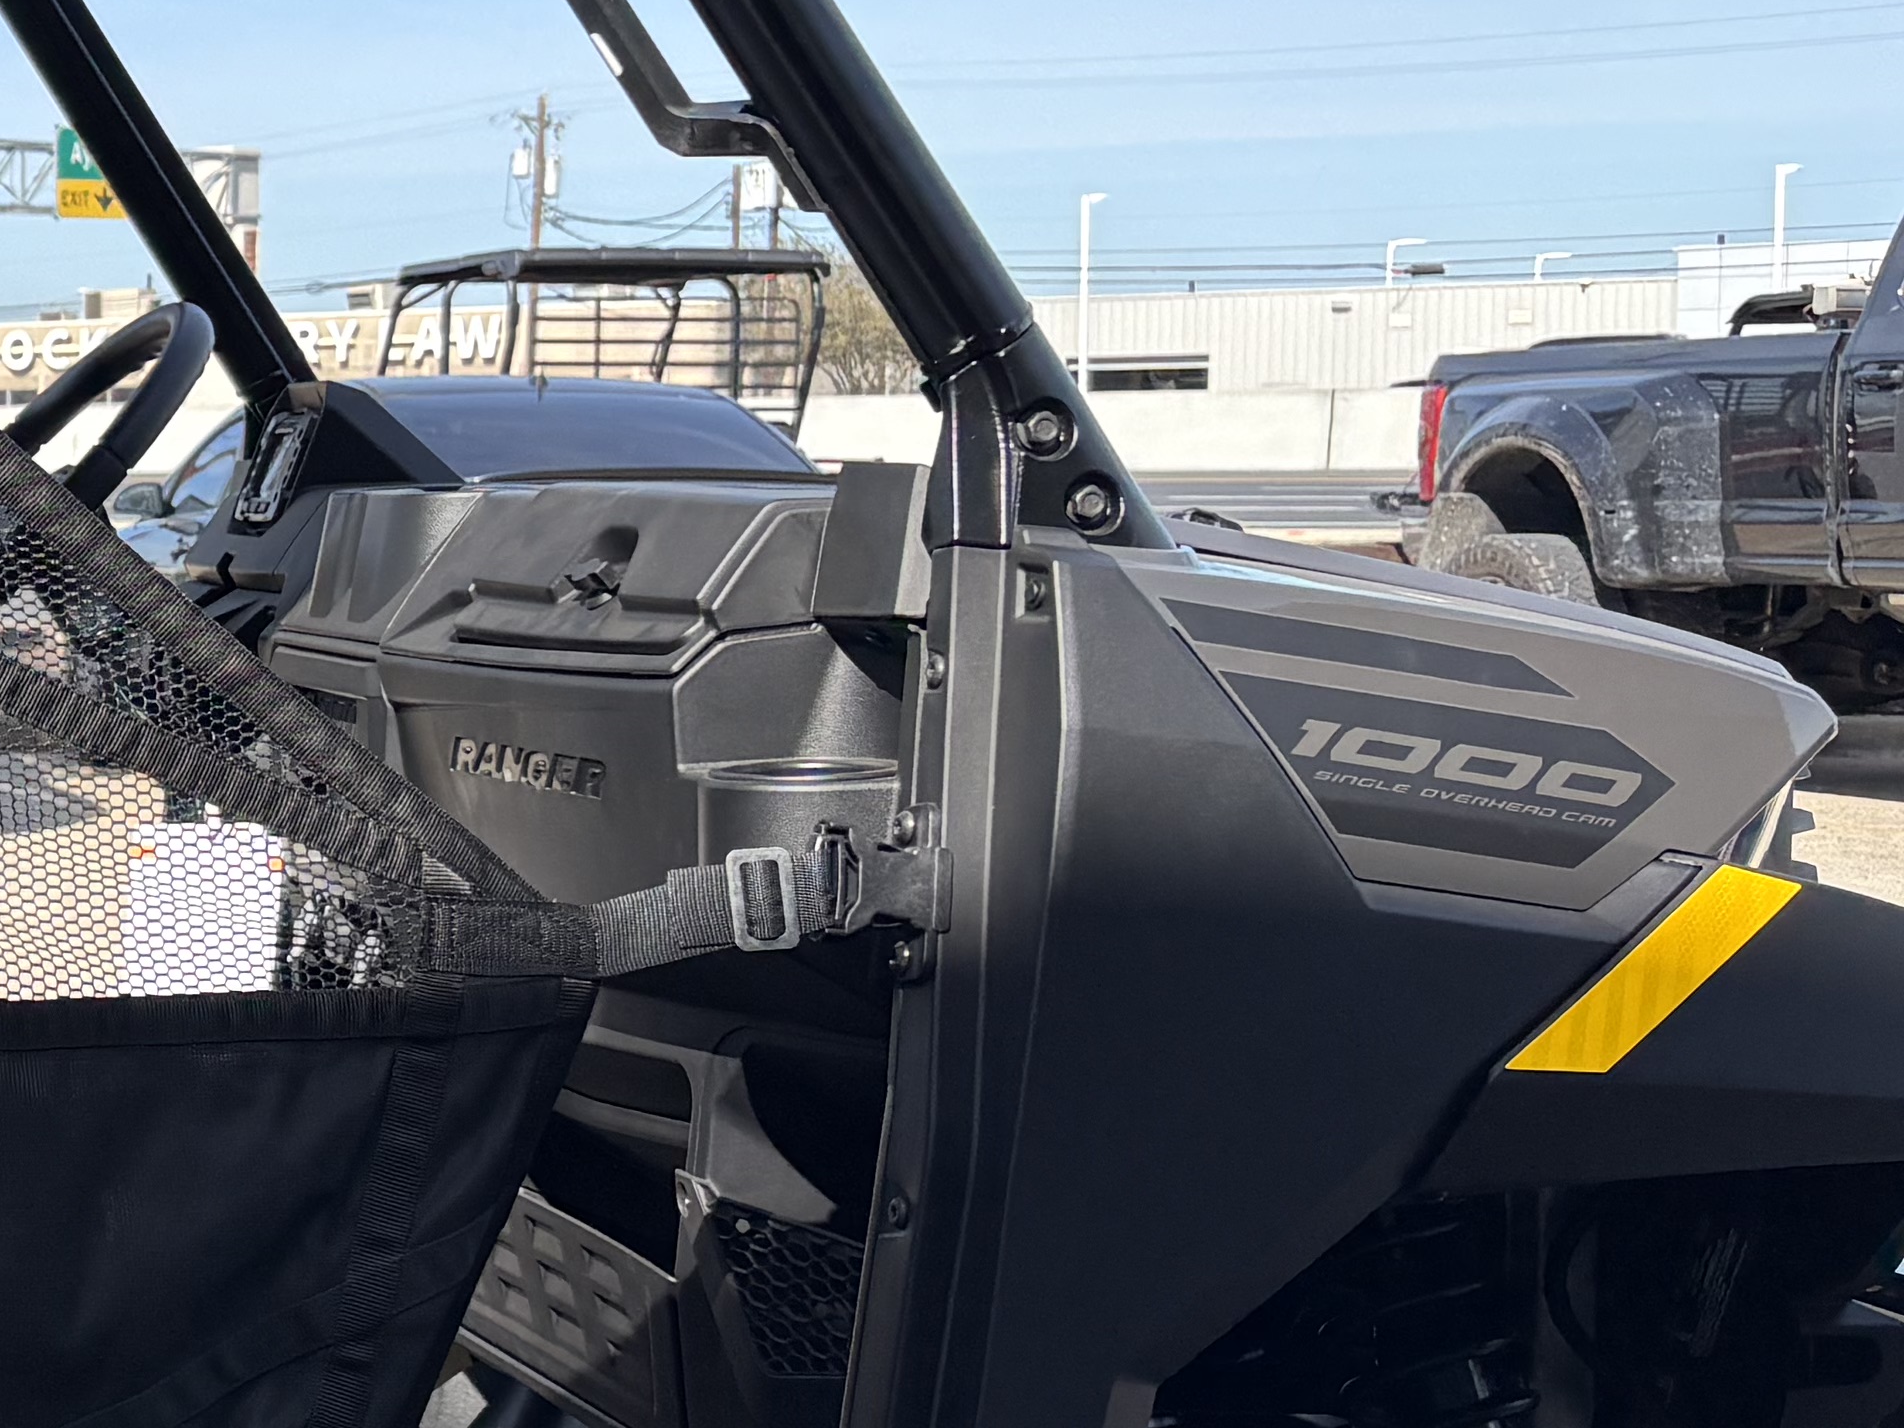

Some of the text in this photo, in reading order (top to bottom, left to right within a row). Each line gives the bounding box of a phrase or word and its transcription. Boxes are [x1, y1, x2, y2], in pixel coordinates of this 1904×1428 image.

[60, 189, 90, 208] EXIT
[377, 314, 502, 362] LAW
[449, 735, 607, 800] RANGER
[1290, 718, 1643, 808] 1000
[1312, 770, 1618, 829] SINGLE OVERHEAD CAM
